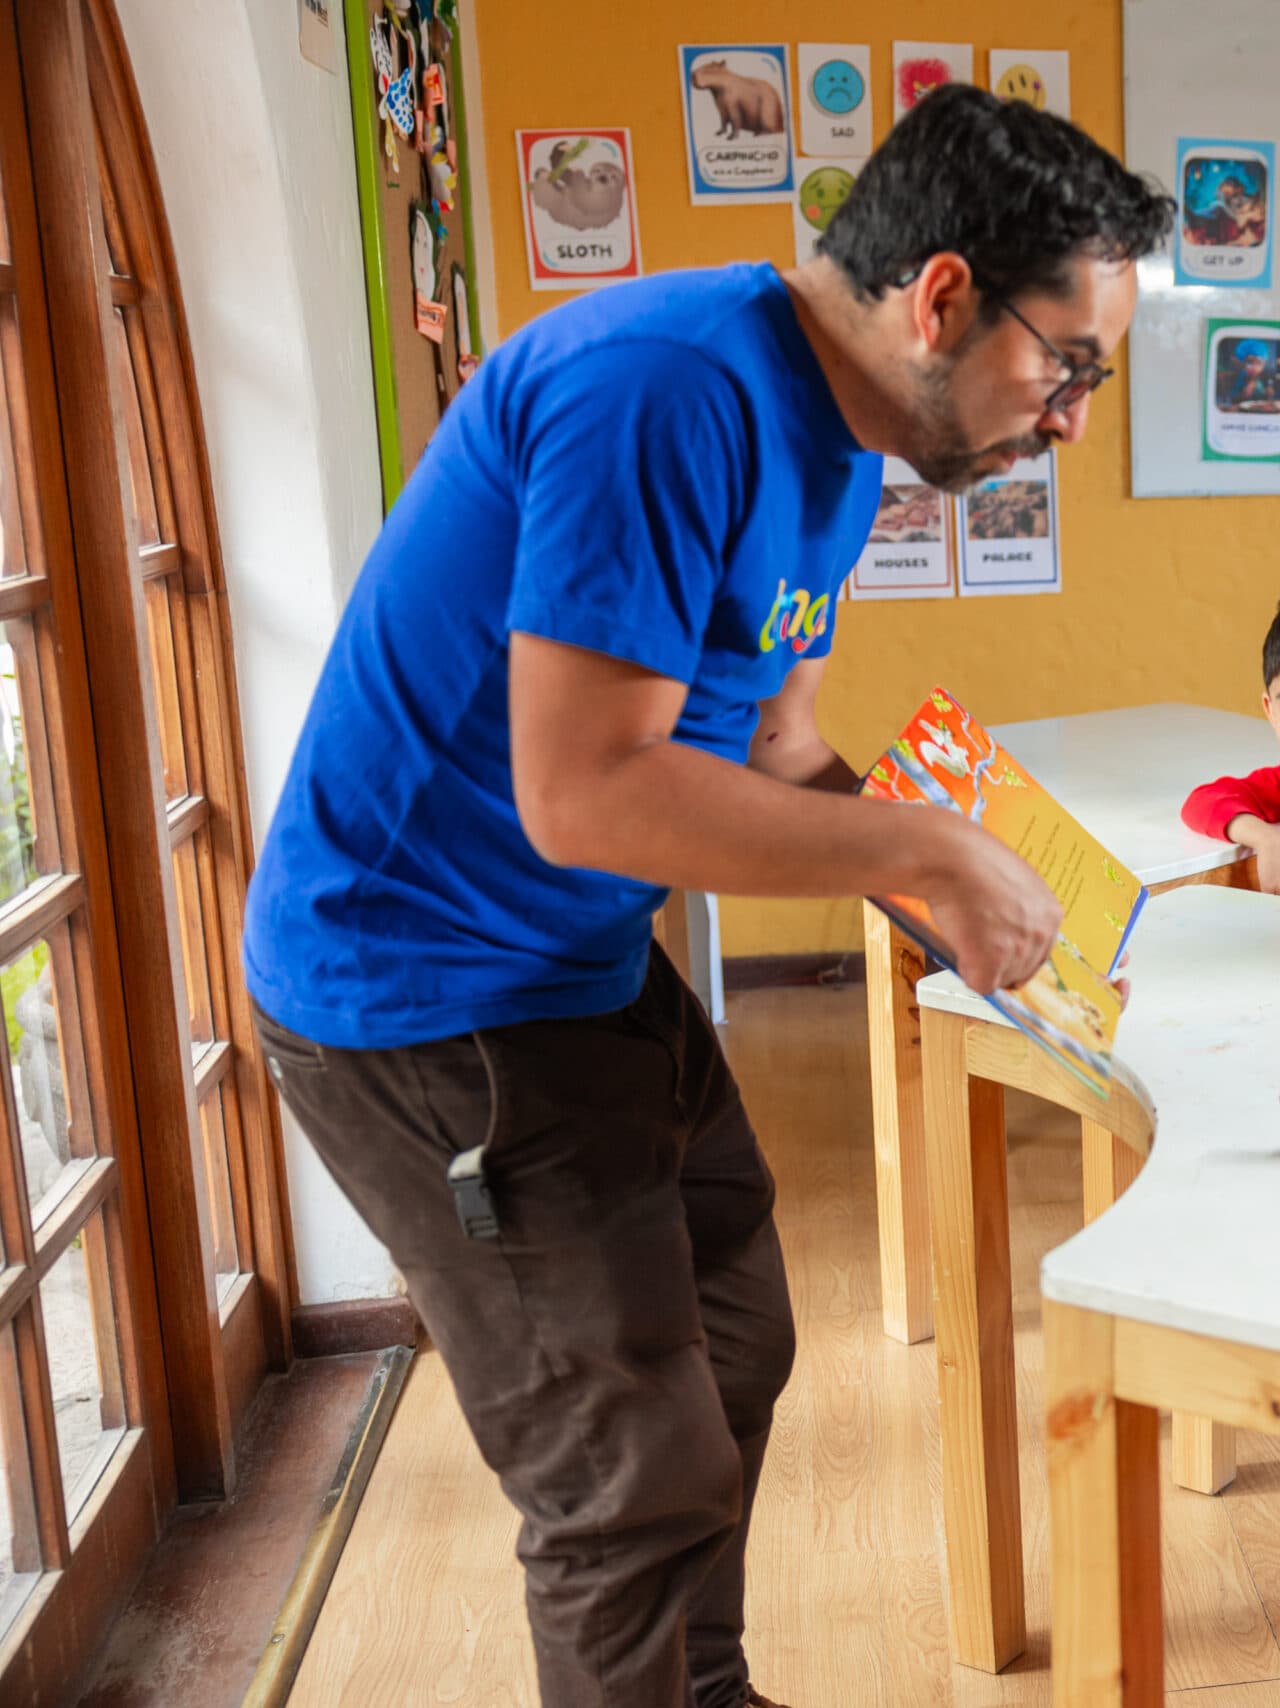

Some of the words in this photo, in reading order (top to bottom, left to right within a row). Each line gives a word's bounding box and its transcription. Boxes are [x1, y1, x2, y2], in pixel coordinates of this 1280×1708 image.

[831, 126, 855, 138] SAD
[705, 150, 779, 163] CARPINCHO
[557, 244, 612, 259] SLOTH
[1203, 255, 1225, 266] GET
[1228, 255, 1245, 266] UP
[982, 551, 1033, 563] PALACE
[874, 558, 929, 569] HOUSES
